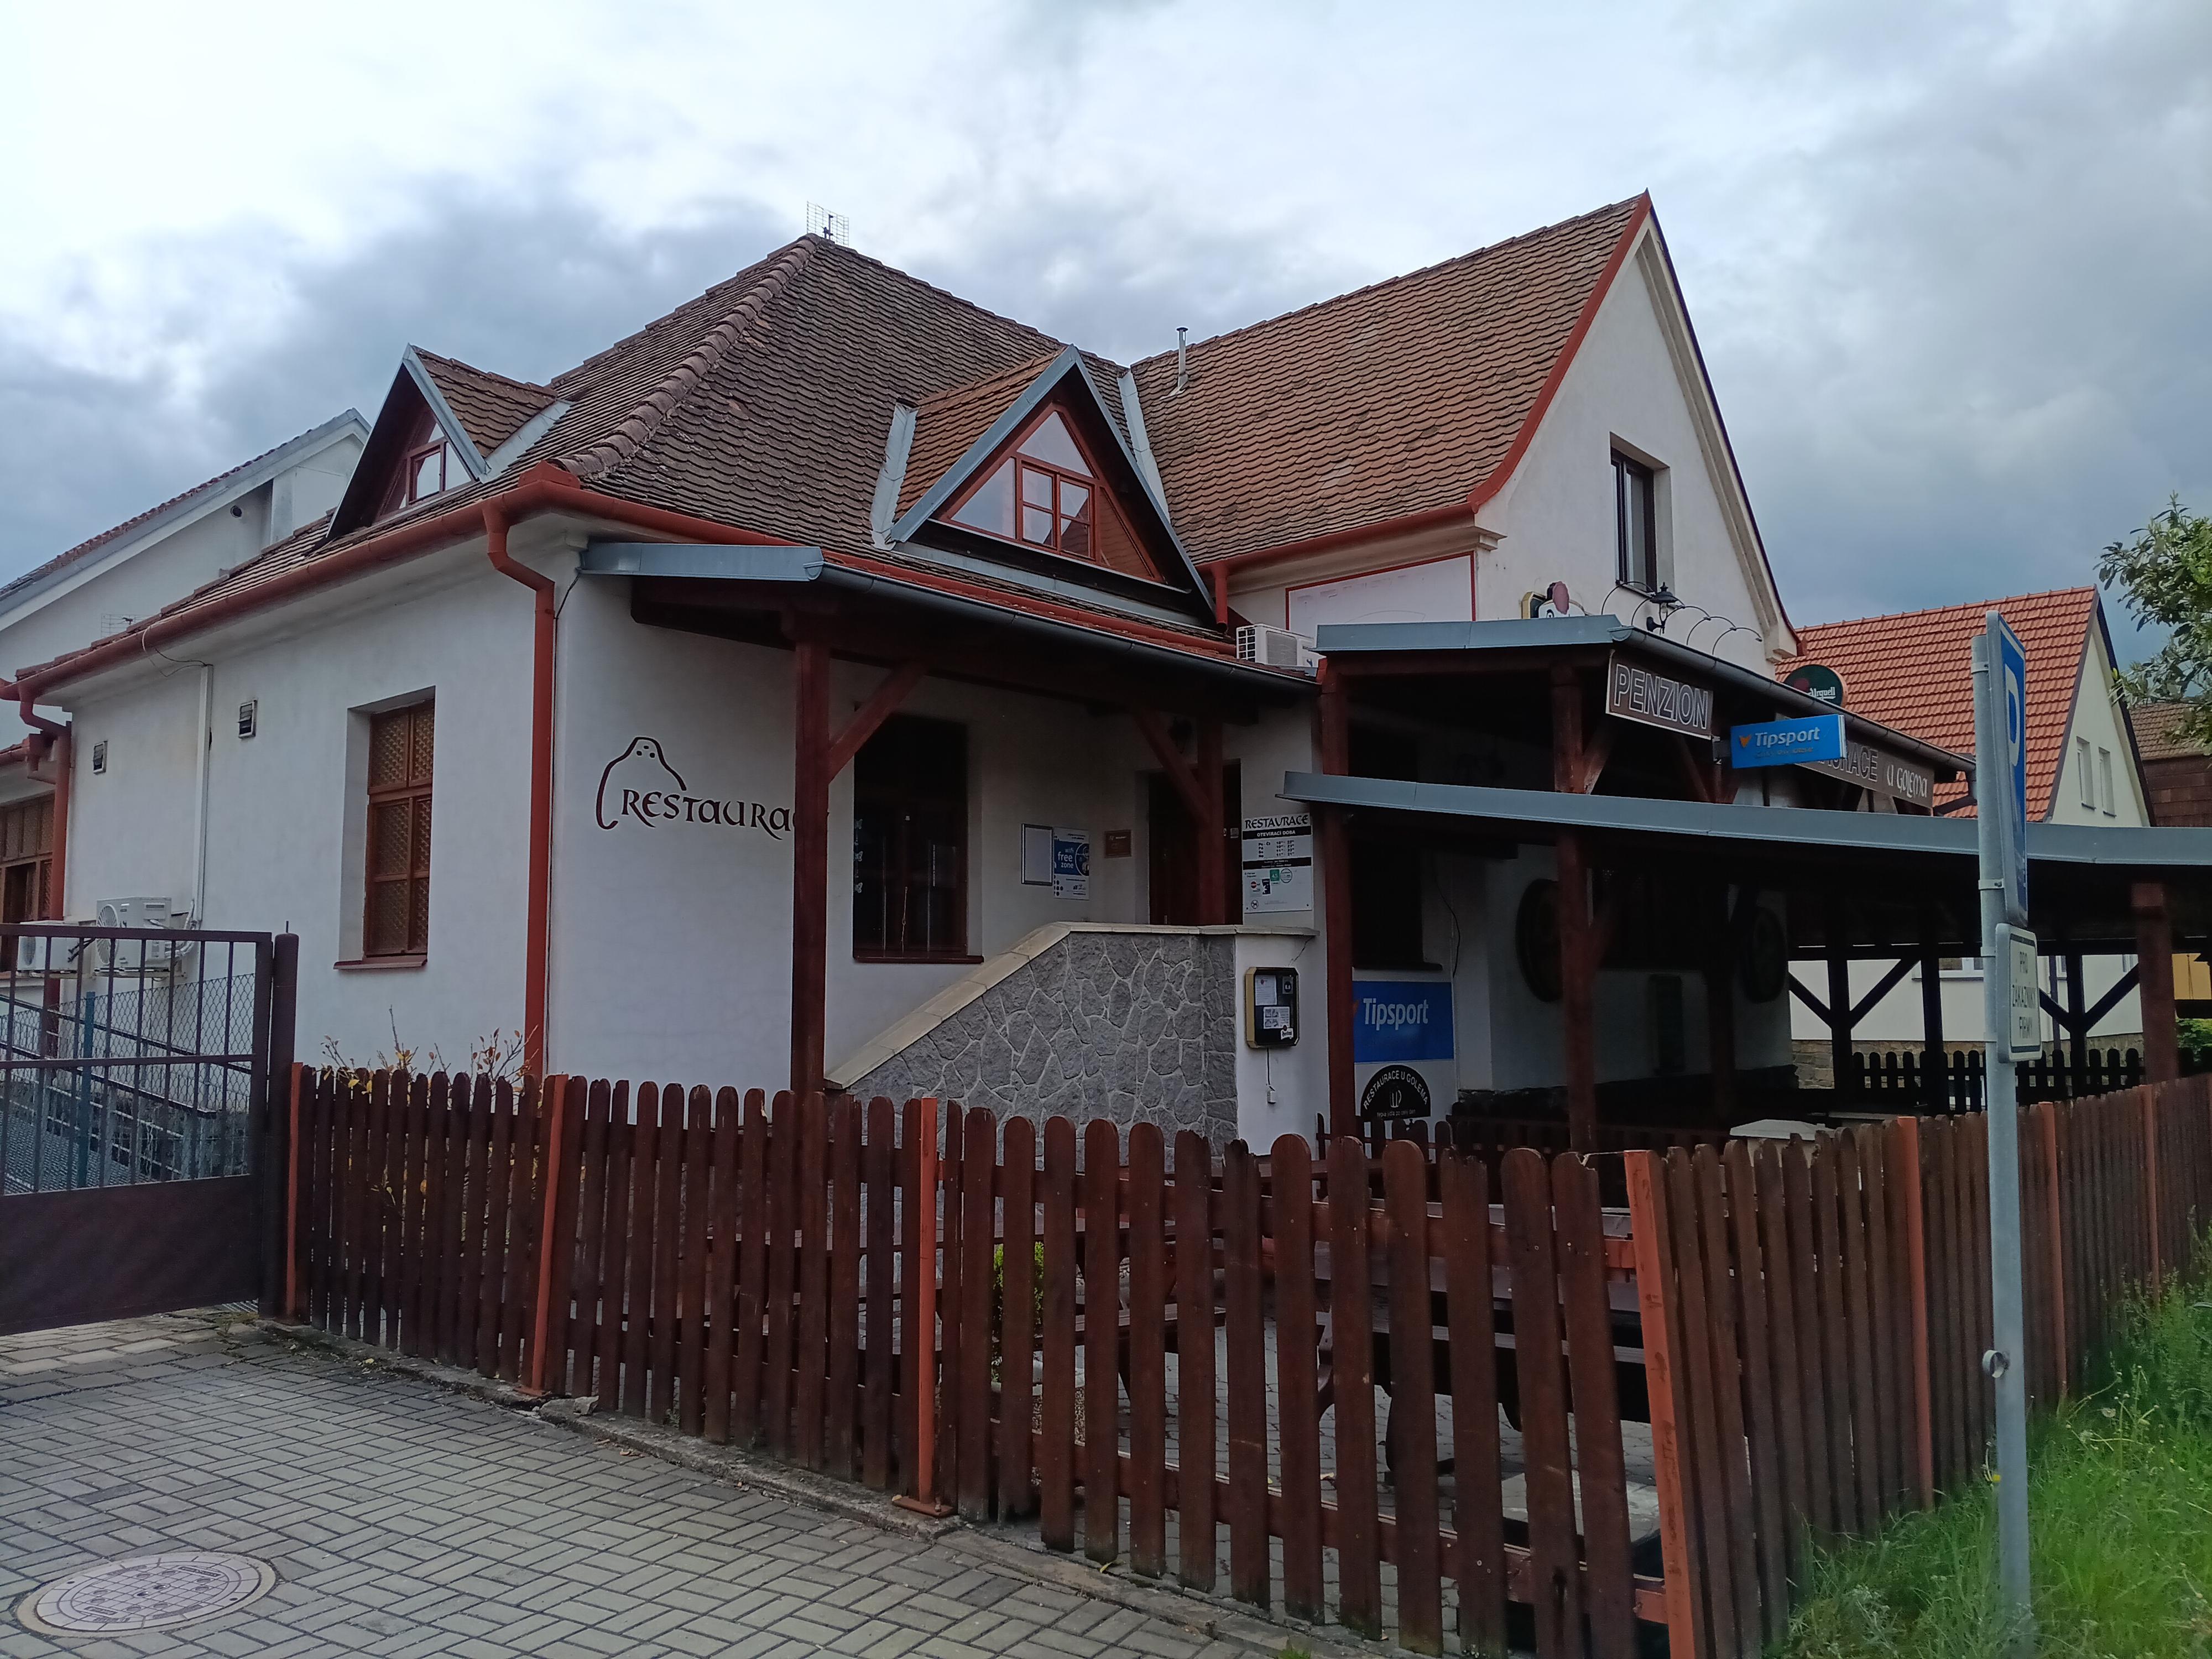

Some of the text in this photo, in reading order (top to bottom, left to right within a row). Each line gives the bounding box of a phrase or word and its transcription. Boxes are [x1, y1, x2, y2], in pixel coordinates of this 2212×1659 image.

[1614, 664, 1708, 729] PENZION
[2005, 664, 2021, 767] P
[1755, 727, 1820, 748] Tipsport
[621, 789, 794, 840] RESTAURA
[1057, 851, 1073, 862] free
[1363, 998, 1430, 1031] Tipsport
[1363, 1070, 1428, 1110] RESTAURACE U GOLEMA
